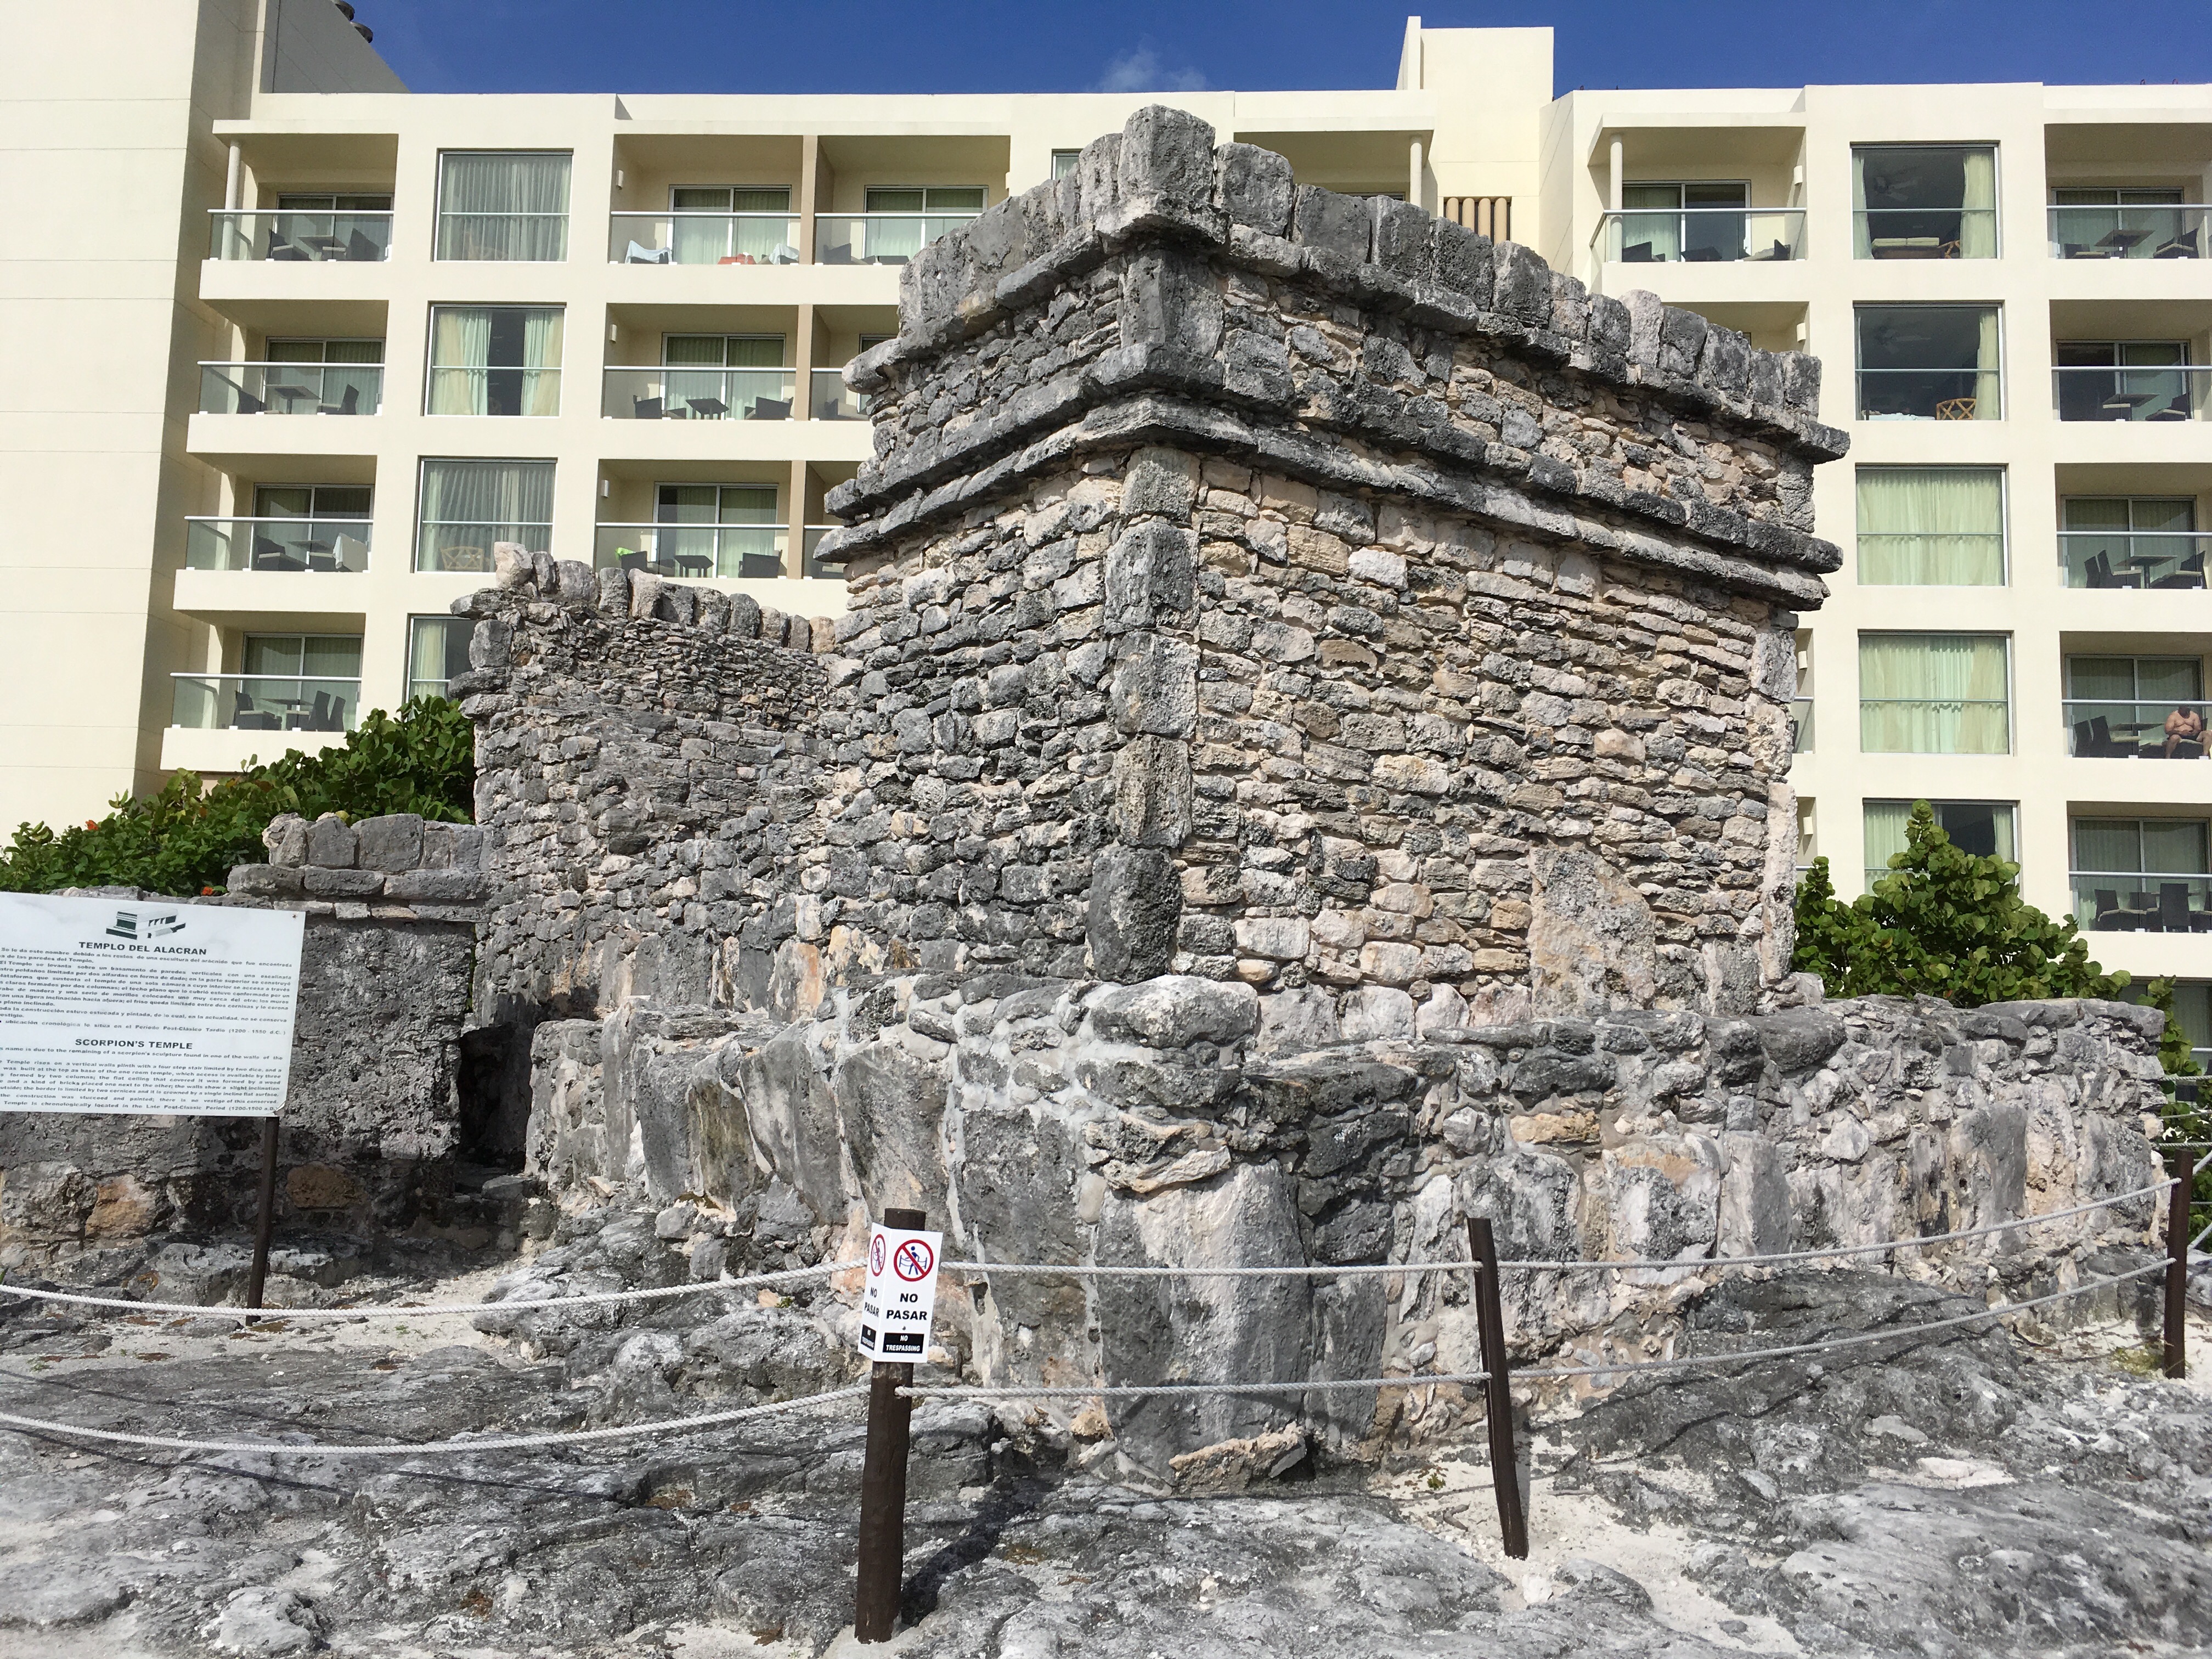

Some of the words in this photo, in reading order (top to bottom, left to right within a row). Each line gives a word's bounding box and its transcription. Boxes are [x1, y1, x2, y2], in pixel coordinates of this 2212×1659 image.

[78, 941, 125, 951] TEMPLO
[153, 946, 207, 956] ALACRAN
[75, 1039, 145, 1048] SCORPION'S
[148, 1041, 193, 1049] TEMPLE
[870, 1286, 877, 1298] NO
[900, 1293, 918, 1302] NO
[864, 1302, 879, 1317] PASAR
[886, 1310, 927, 1321] PASAR
